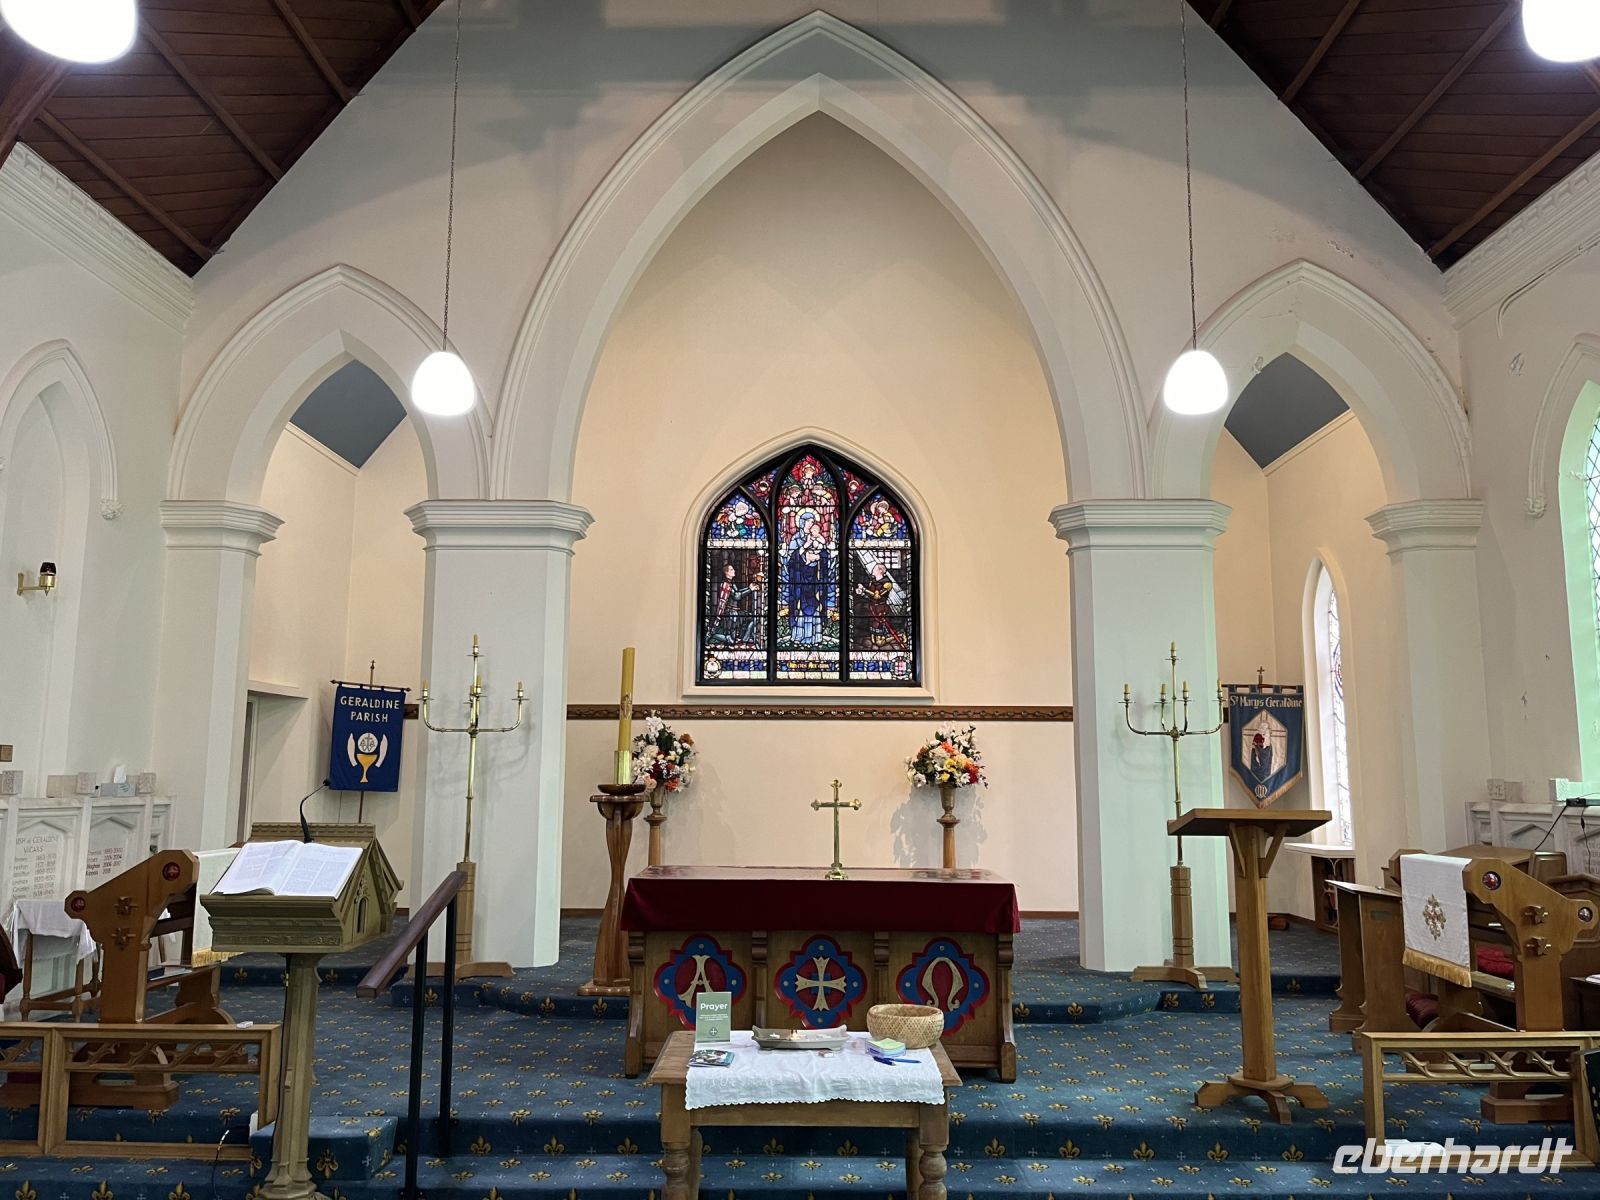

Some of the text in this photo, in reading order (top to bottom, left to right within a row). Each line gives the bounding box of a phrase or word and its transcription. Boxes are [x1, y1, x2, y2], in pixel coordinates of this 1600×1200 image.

[340, 696, 400, 709] GERALDINE
[1265, 696, 1302, 708] Geraldine
[350, 711, 388, 723] PARISH
[700, 1002, 728, 1012] Prayer
